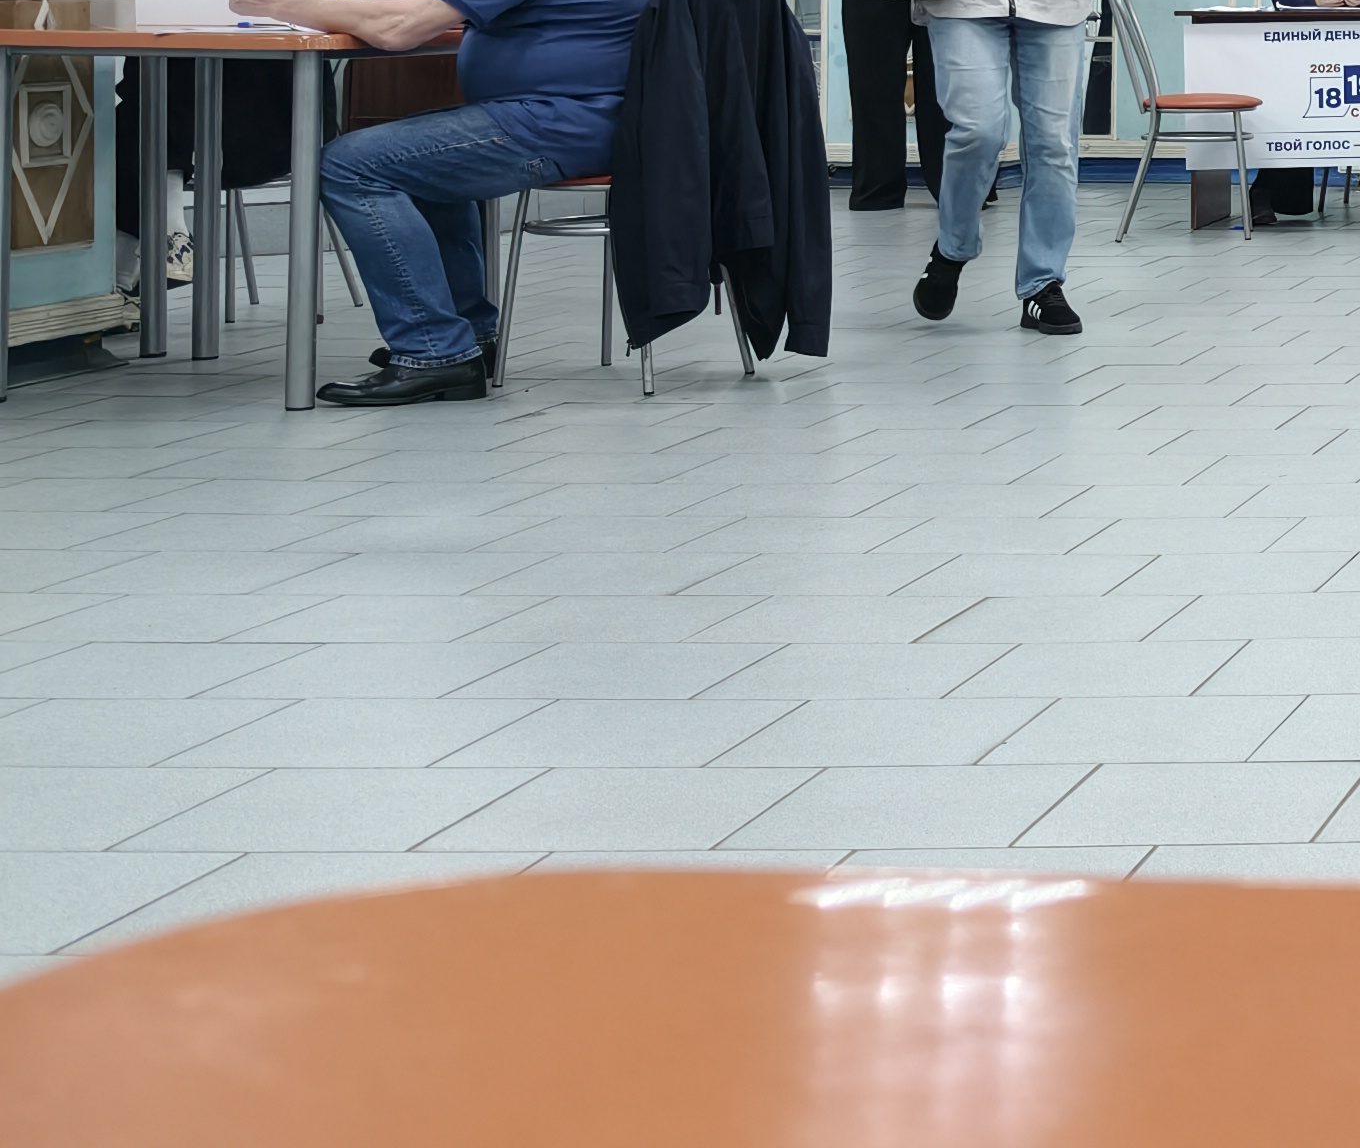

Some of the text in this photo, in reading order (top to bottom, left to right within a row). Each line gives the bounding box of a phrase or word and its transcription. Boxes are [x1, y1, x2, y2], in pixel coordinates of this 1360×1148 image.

[1263, 28, 1322, 43] ЕДИНЫЙ
[1324, 29, 1360, 42] ДЕНЬ
[1309, 63, 1341, 74] 2026
[1314, 87, 1342, 109] 18
[1266, 138, 1303, 152] ТВОЙ
[1306, 139, 1350, 151] ГОЛОС
